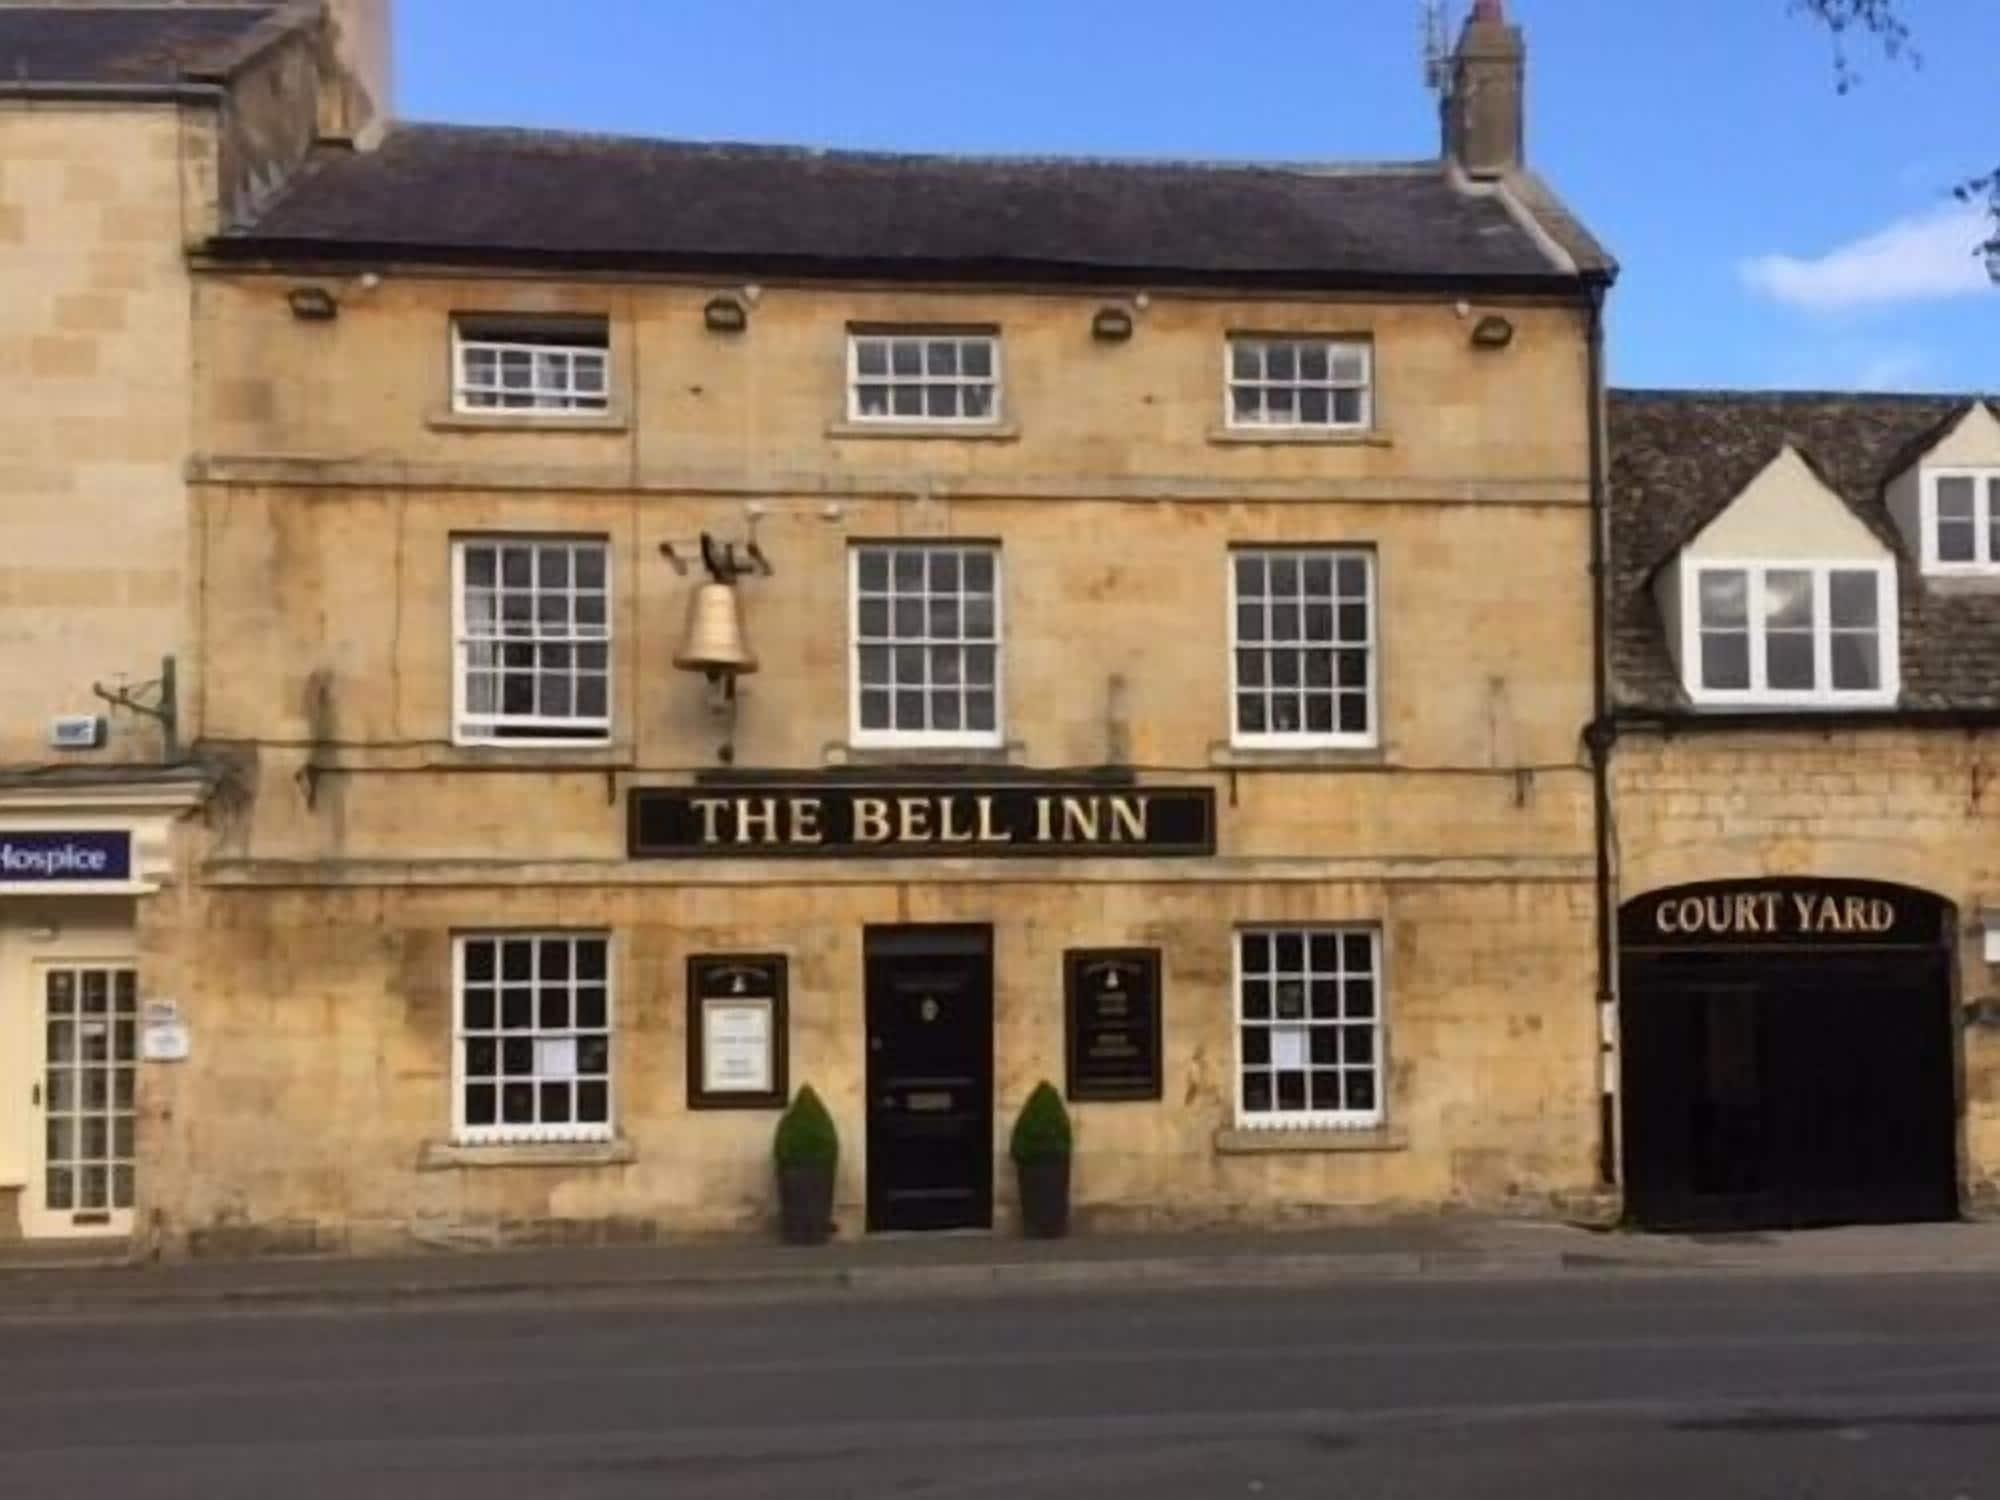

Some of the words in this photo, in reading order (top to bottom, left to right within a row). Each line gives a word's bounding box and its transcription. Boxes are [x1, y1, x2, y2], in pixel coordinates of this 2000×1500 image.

[691, 799, 823, 843] THE
[852, 797, 1012, 843] BELL
[1036, 796, 1151, 842] INN
[1656, 892, 1782, 933] COURT
[1793, 894, 1896, 932] YARD
